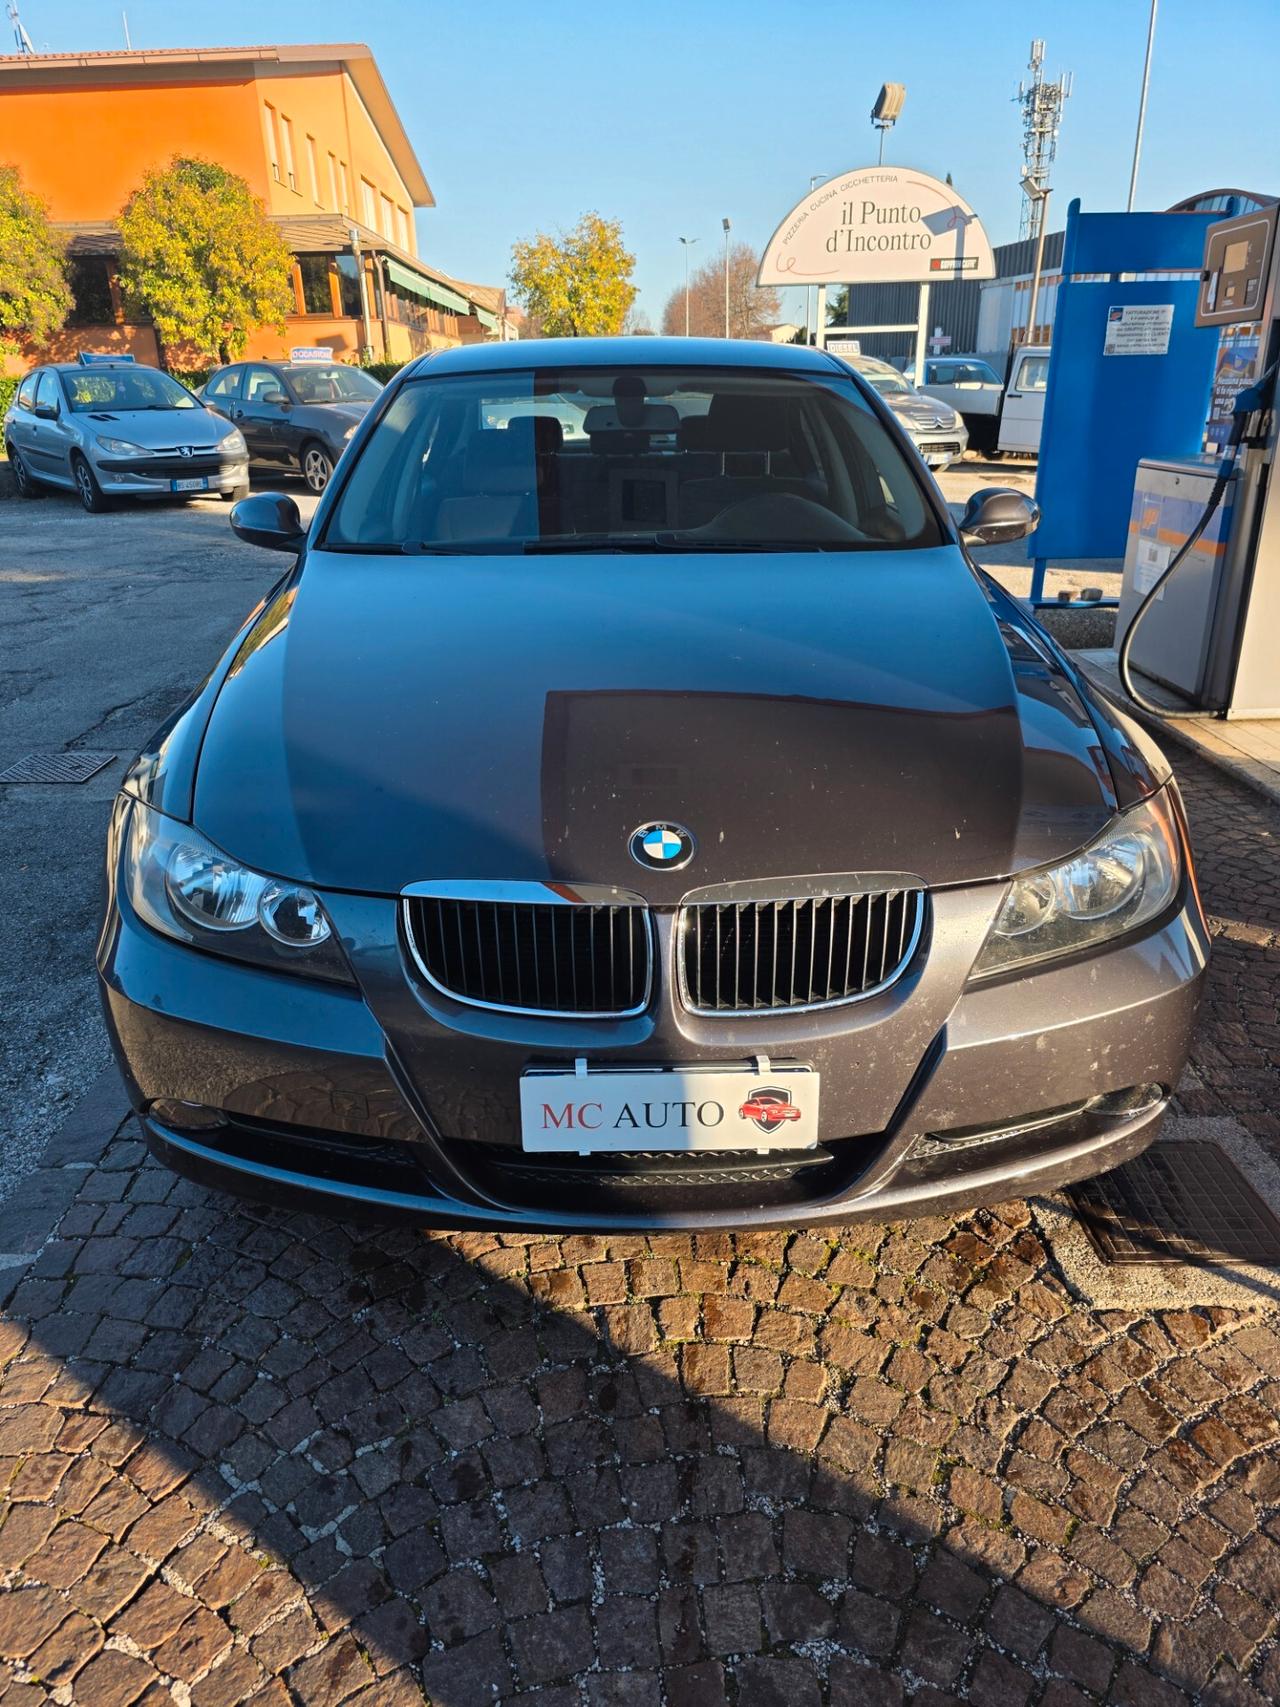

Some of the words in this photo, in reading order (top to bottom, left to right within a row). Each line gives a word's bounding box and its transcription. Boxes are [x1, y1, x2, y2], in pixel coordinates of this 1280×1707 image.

[782, 212, 809, 245] PIZZERIA
[809, 189, 838, 211] CUCINA
[840, 175, 898, 191] CICCHETTERIA
[842, 201, 853, 225] il
[860, 201, 921, 225] Punto
[826, 229, 932, 253] d'Incontro
[829, 343, 858, 352] DIESEL
[541, 1102, 603, 1129] MC
[612, 1100, 725, 1129] AUTO
